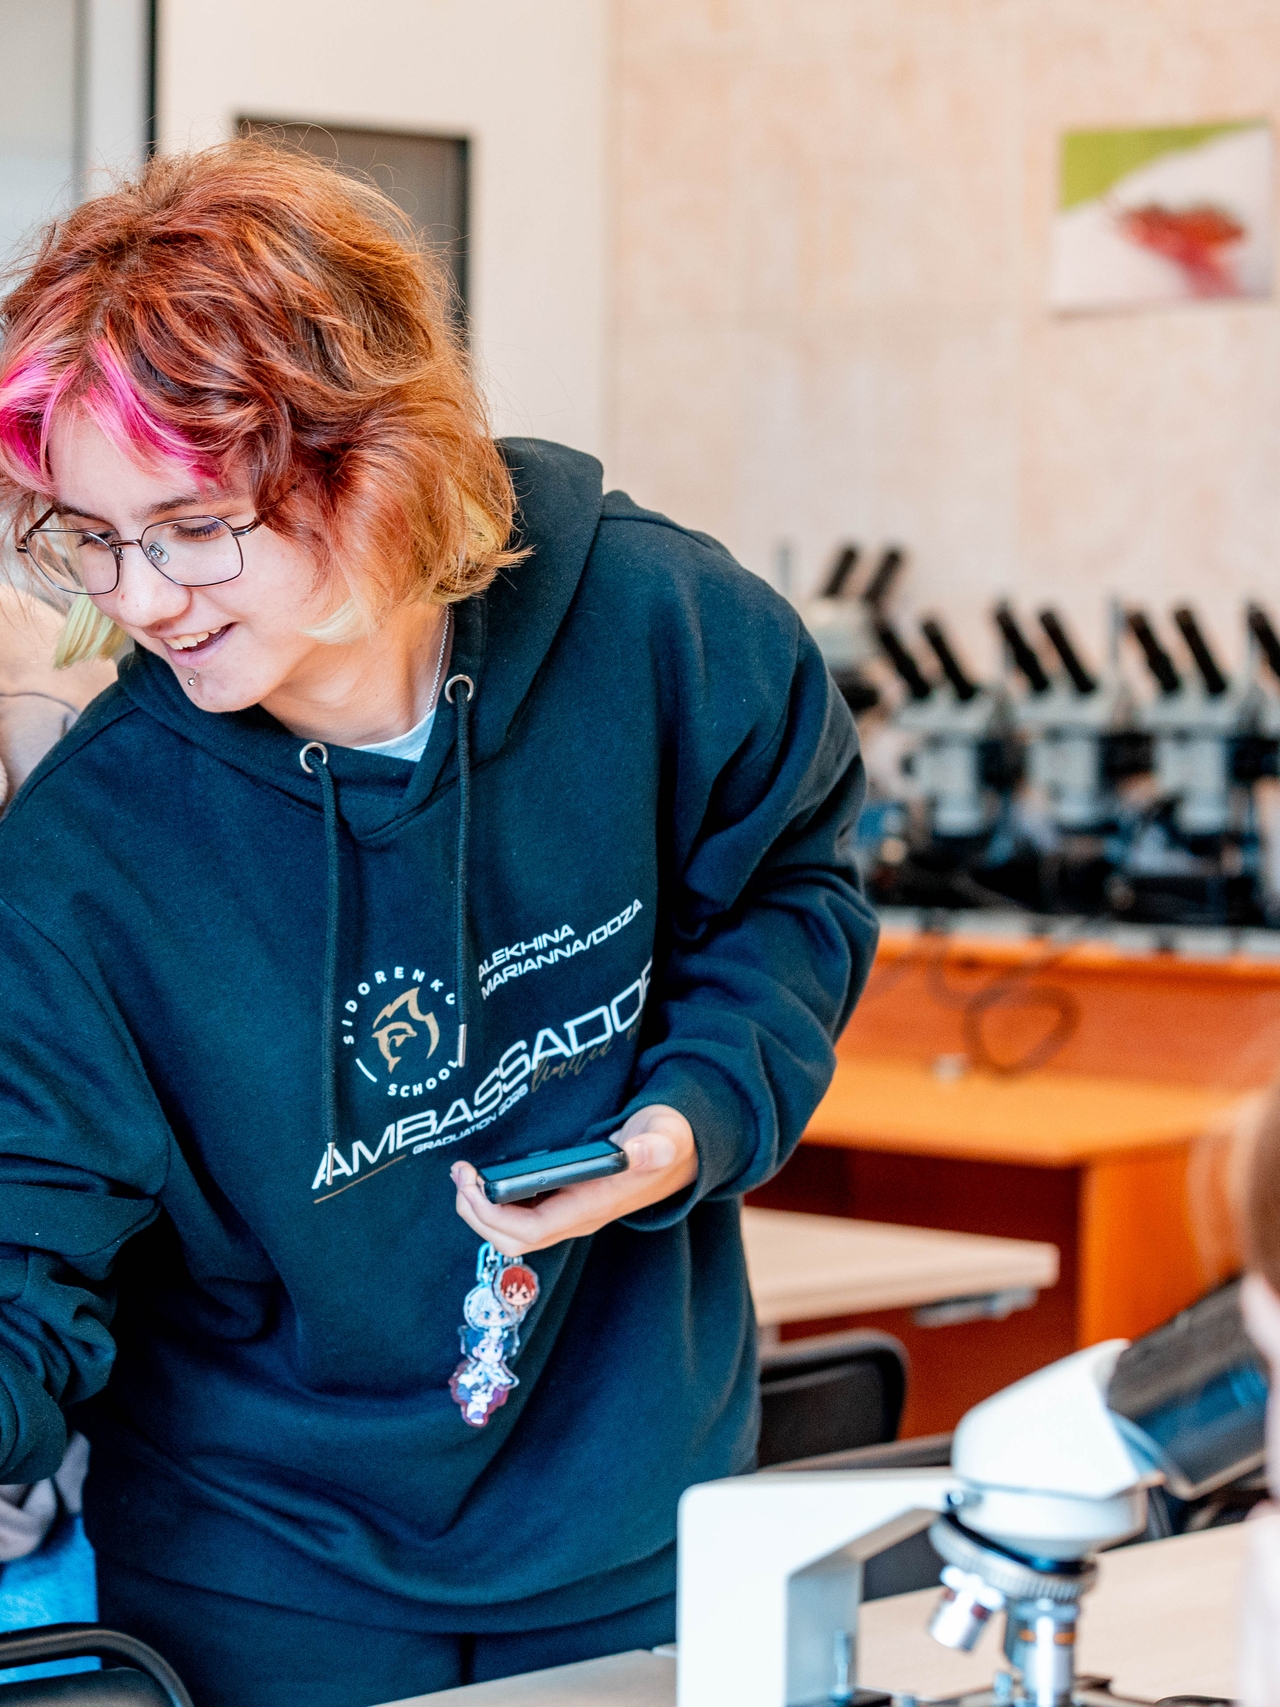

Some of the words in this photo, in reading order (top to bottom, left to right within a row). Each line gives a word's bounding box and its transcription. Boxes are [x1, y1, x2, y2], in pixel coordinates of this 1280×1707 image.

[478, 924, 575, 982] ALEKHINA
[481, 899, 643, 1000] MARIANNA/DOZA
[387, 1060, 458, 1098] SCHOOL
[412, 1112, 497, 1155] GRADUATION
